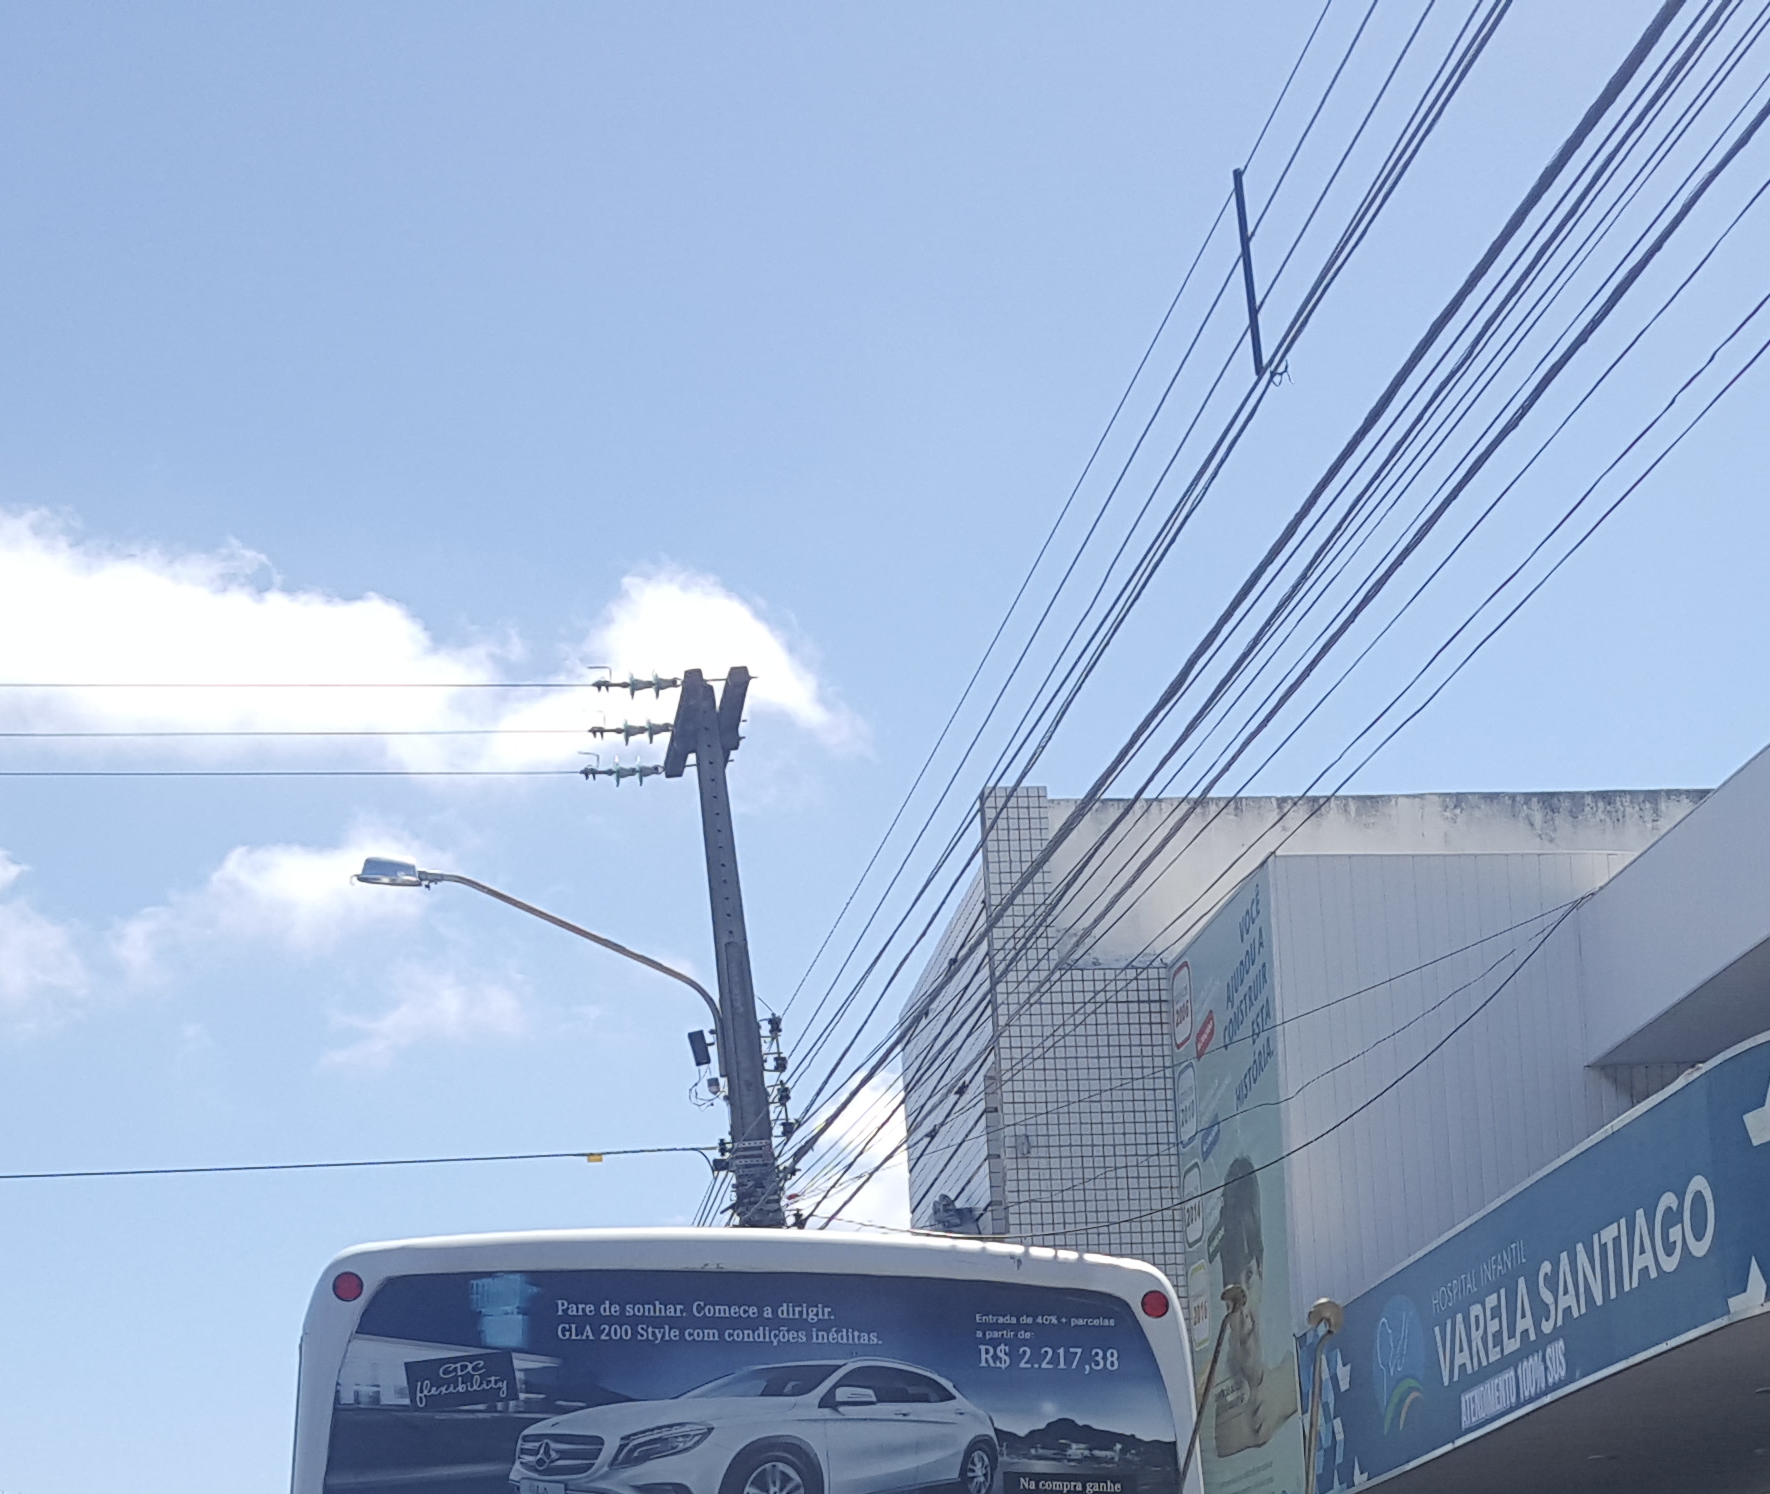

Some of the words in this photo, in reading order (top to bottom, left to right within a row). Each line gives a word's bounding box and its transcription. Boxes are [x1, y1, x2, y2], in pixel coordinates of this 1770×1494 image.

[1239, 883, 1261, 943] VOCÊ
[1226, 936, 1256, 1010] AJUDOU
[1257, 926, 1265, 955] A
[1223, 962, 1268, 1050] CONSTRUIR
[1251, 996, 1272, 1045] ESTA
[1432, 1271, 1478, 1315] HOSPITAL
[1480, 1239, 1527, 1287] INFANTIL
[1434, 1276, 1537, 1386] VARELA
[1538, 1175, 1716, 1334] SANTIAGO
[557, 1300, 595, 1316] Pare
[600, 1301, 620, 1316] de
[625, 1301, 687, 1317] sonhar.
[692, 1301, 759, 1318] Comece
[763, 1306, 773, 1318] a
[778, 1303, 835, 1323] dirigir.
[976, 1313, 1017, 1324] Entrada
[1019, 1314, 1033, 1324] de
[1071, 1317, 1115, 1327] parcelas
[557, 1324, 594, 1340] GLA
[600, 1324, 631, 1340] 200
[637, 1324, 680, 1344] Style
[684, 1329, 719, 1341] com
[724, 1326, 807, 1346] condições
[812, 1327, 883, 1345] inéditas.
[985, 1330, 1015, 1340] partir
[439, 1360, 487, 1378] CDC
[979, 1343, 1011, 1370] R$
[1018, 1347, 1119, 1374] 2.217,38
[416, 1374, 507, 1408] flexibility
[1461, 1368, 1516, 1431] ATENDIMENTO
[1517, 1350, 1546, 1403] 100%
[1545, 1339, 1566, 1383] SUS
[1019, 1477, 1036, 1490] Na
[1039, 1480, 1083, 1493] compra
[1085, 1480, 1122, 1494] ganhe
